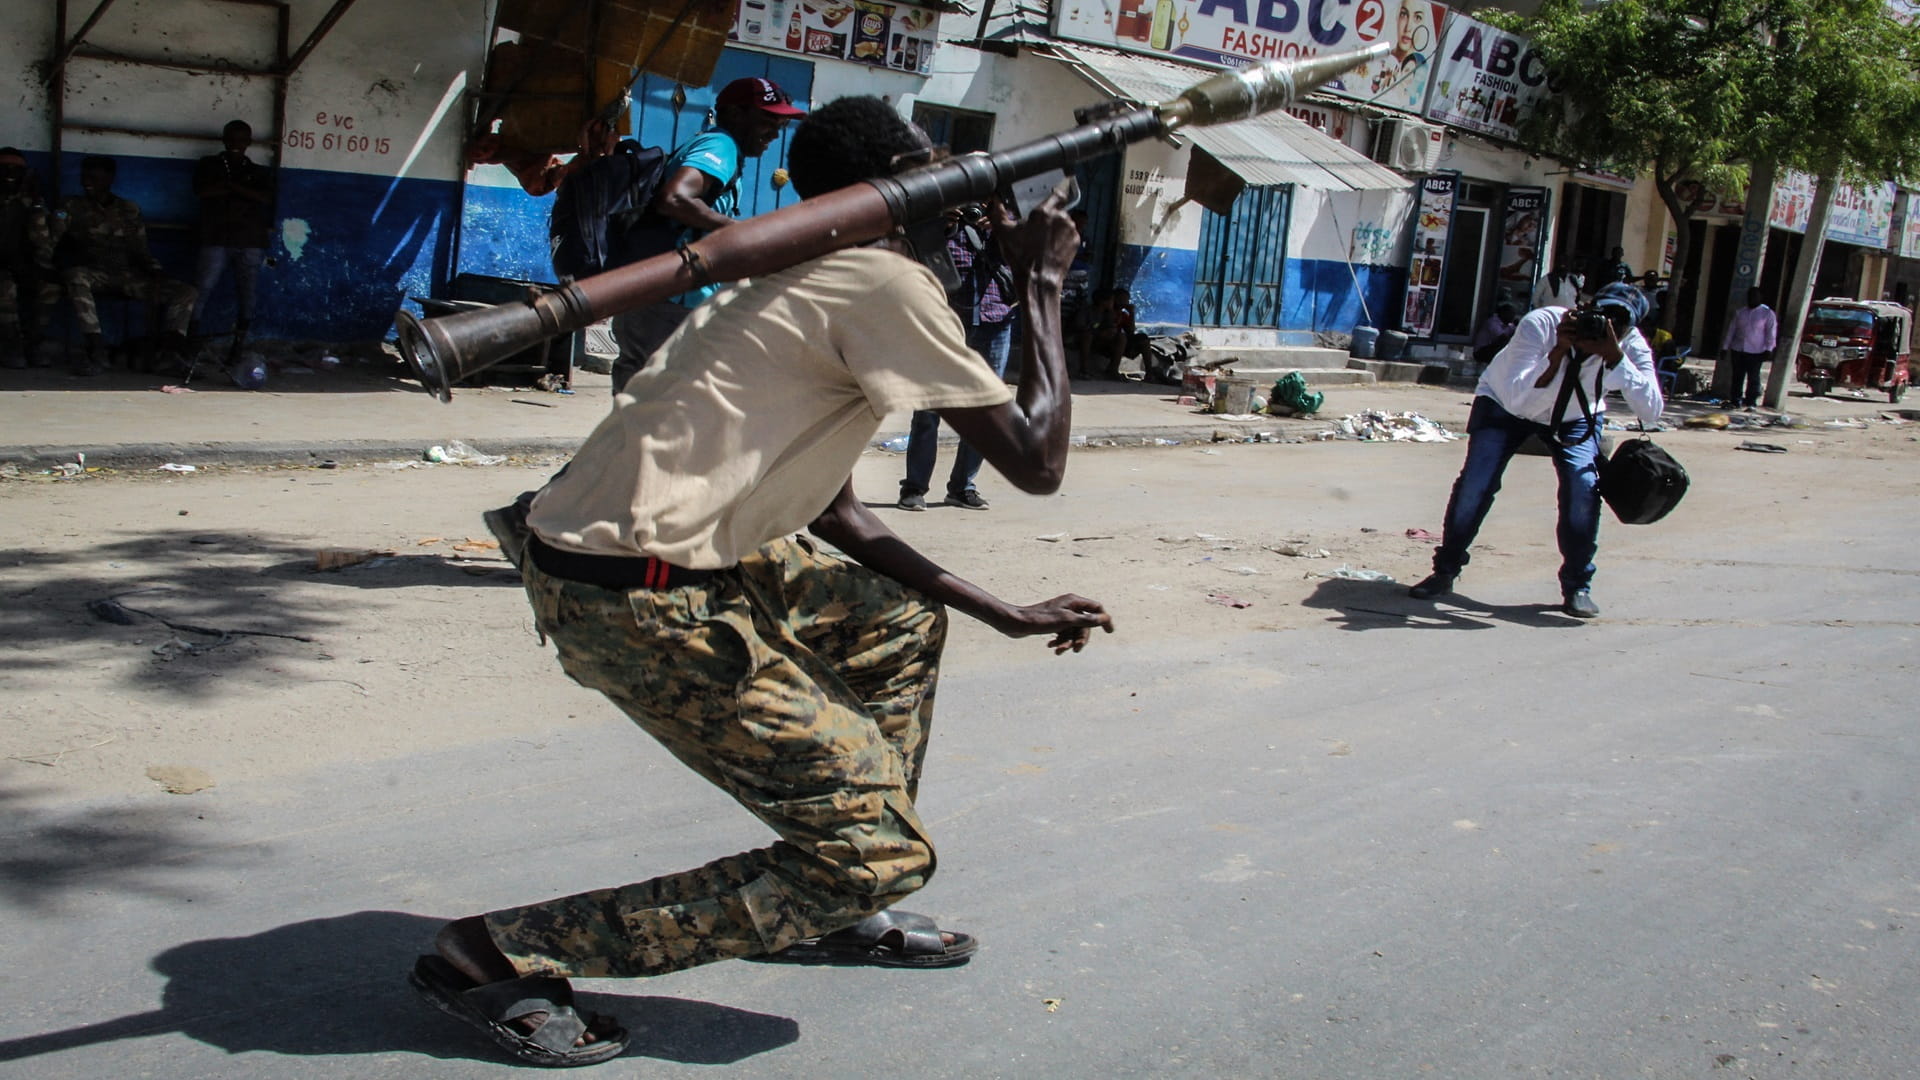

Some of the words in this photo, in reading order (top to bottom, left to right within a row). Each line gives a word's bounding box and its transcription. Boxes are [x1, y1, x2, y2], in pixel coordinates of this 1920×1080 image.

[1451, 25, 1546, 88] ABC
[1474, 71, 1519, 95] FASHION
[287, 129, 316, 150] 615
[1424, 179, 1445, 191] ABC
[1511, 198, 1532, 208] ABC
